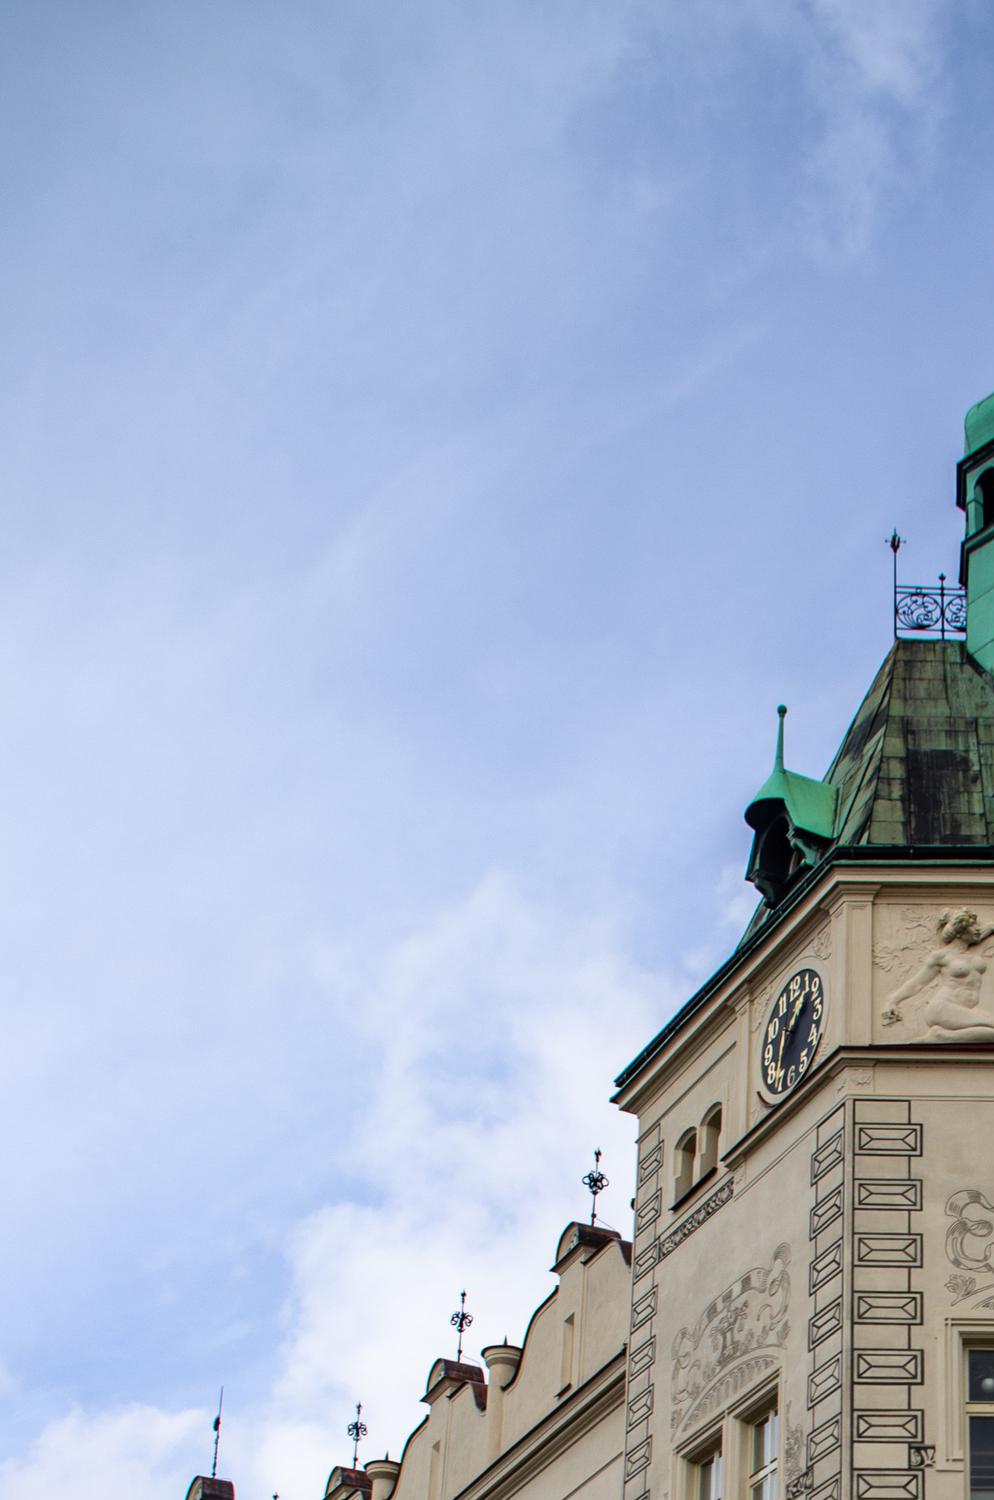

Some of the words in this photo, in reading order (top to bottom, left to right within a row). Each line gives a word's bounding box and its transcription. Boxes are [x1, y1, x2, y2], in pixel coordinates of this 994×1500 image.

[789, 976, 801, 1003] 12
[804, 973, 809, 993] 1
[811, 977, 819, 1001] 2
[779, 993, 787, 1017] 11
[813, 997, 822, 1021] 3
[767, 1018, 779, 1043] 10
[808, 1023, 817, 1046] 4
[764, 1044, 773, 1066] 9
[799, 1048, 808, 1073] 5
[767, 1062, 776, 1085] 8
[787, 1065, 795, 1088] 6
